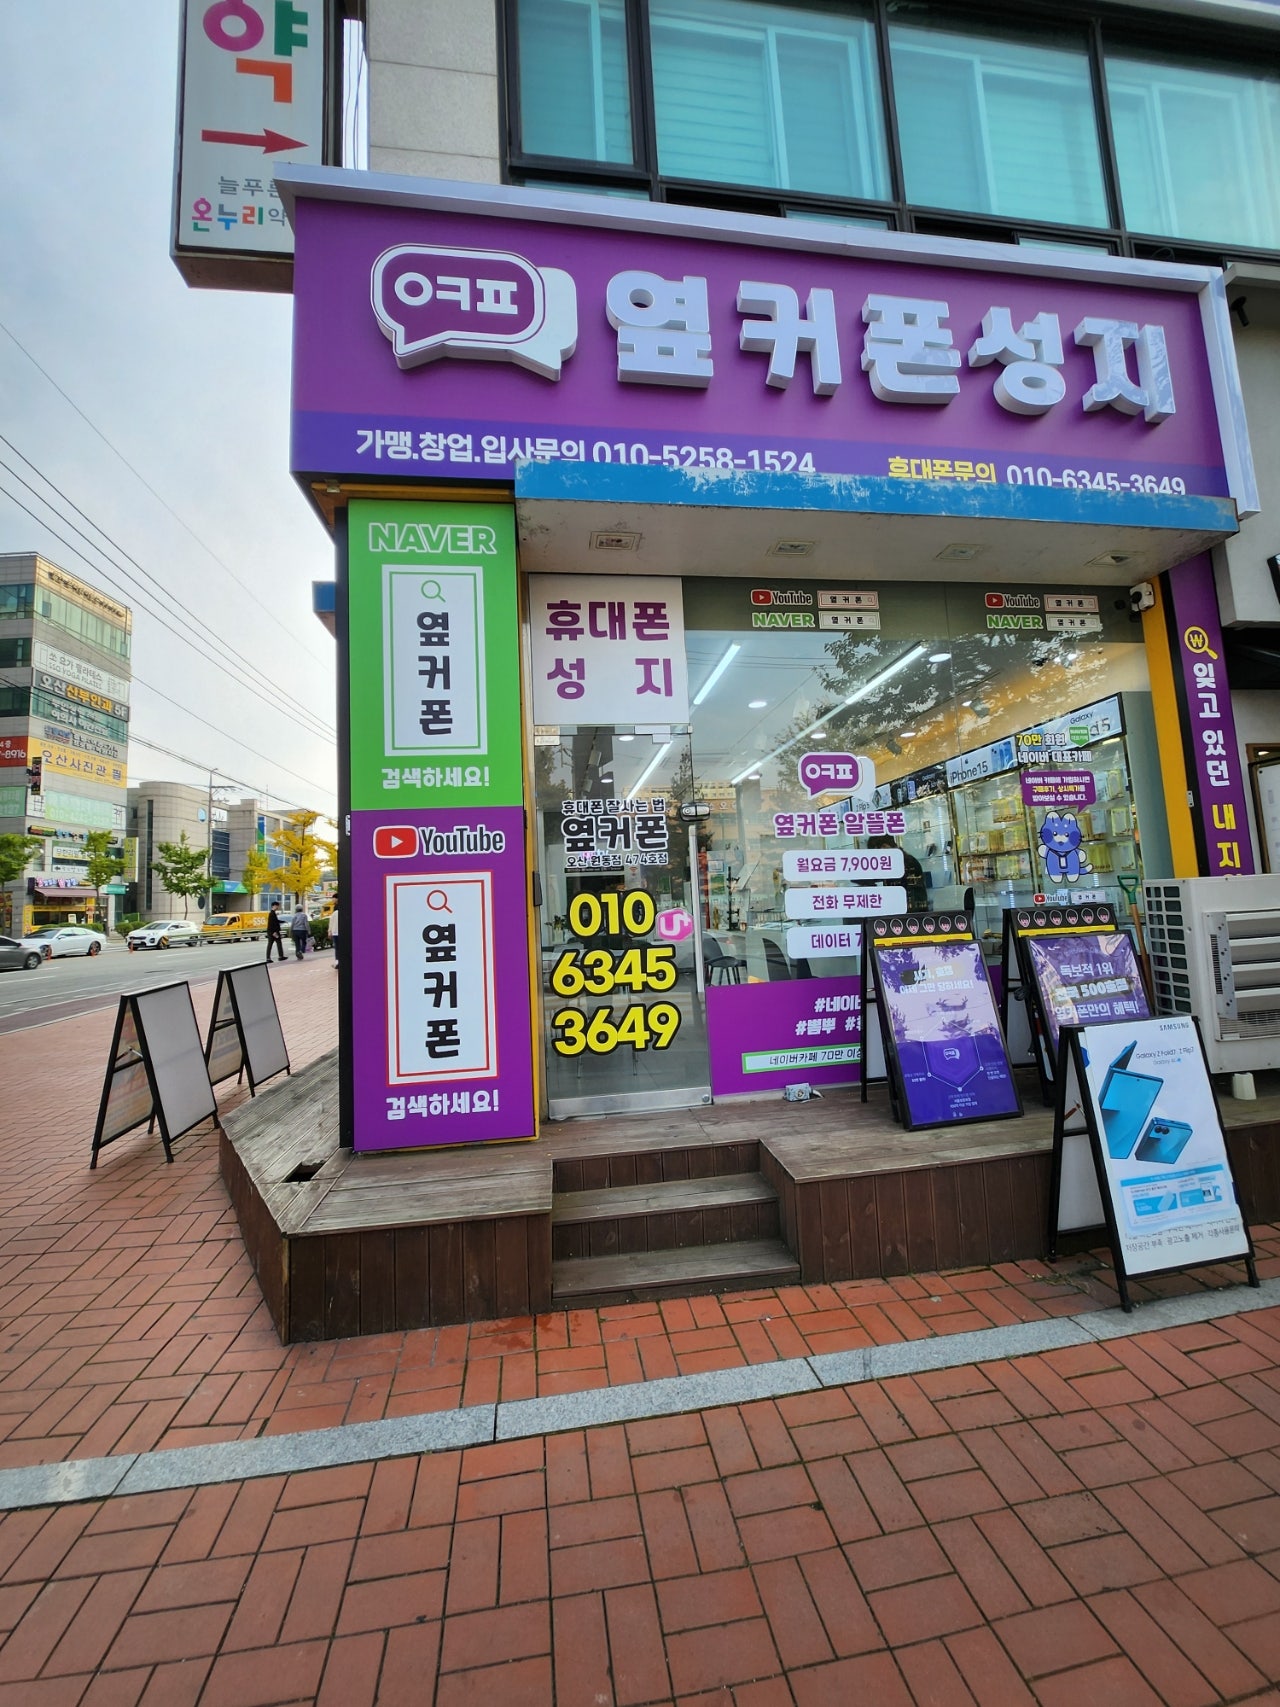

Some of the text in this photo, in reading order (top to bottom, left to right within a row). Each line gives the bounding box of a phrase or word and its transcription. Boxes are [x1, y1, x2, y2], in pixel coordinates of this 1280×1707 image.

[203, 0, 309, 104] 약
[592, 442, 816, 473] 010-5258-1524
[1006, 464, 1186, 496] 010-6345-3649
[369, 522, 497, 555] NAVER
[772, 591, 813, 606] YouTube
[1004, 594, 1040, 608] YouTube
[545, 600, 670, 642] 휴대폰
[752, 612, 815, 628] NAVER
[986, 614, 1044, 629] NAVER
[40, 675, 66, 697] 오산
[66, 684, 113, 714] 산부인과
[113, 703, 128, 718] 5F
[1193, 662, 1221, 719] 잊고
[1069, 711, 1094, 725] Galaxy
[1016, 733, 1043, 747] 70만
[1043, 732, 1067, 747] 회원
[1017, 750, 1050, 764] 네이버
[1202, 729, 1231, 788] 있던
[381, 766, 490, 789] 검색하세요!
[561, 799, 603, 815] 휴대폰
[774, 810, 906, 838] 옆커폰 알뜰폰
[419, 824, 506, 855] YouTube
[561, 815, 669, 853] 옆커폰
[566, 855, 588, 868] 오산
[624, 851, 669, 866] 474호점
[796, 855, 893, 873] 월요금 7,900원
[811, 893, 883, 910] 전화 무제한
[567, 889, 657, 938] 010
[811, 932, 851, 949] 데이터
[551, 945, 677, 997] 6345
[1095, 960, 1115, 976] 1위
[1112, 999, 1140, 1016] 혜택!
[552, 1002, 681, 1056] 3649
[1159, 1021, 1190, 1032] SAMSUNG
[769, 1052, 818, 1066] 네이버카페
[821, 1050, 844, 1061] 70만
[1135, 1050, 1156, 1060] Galaxy
[385, 1089, 499, 1121] 검색하세요!
